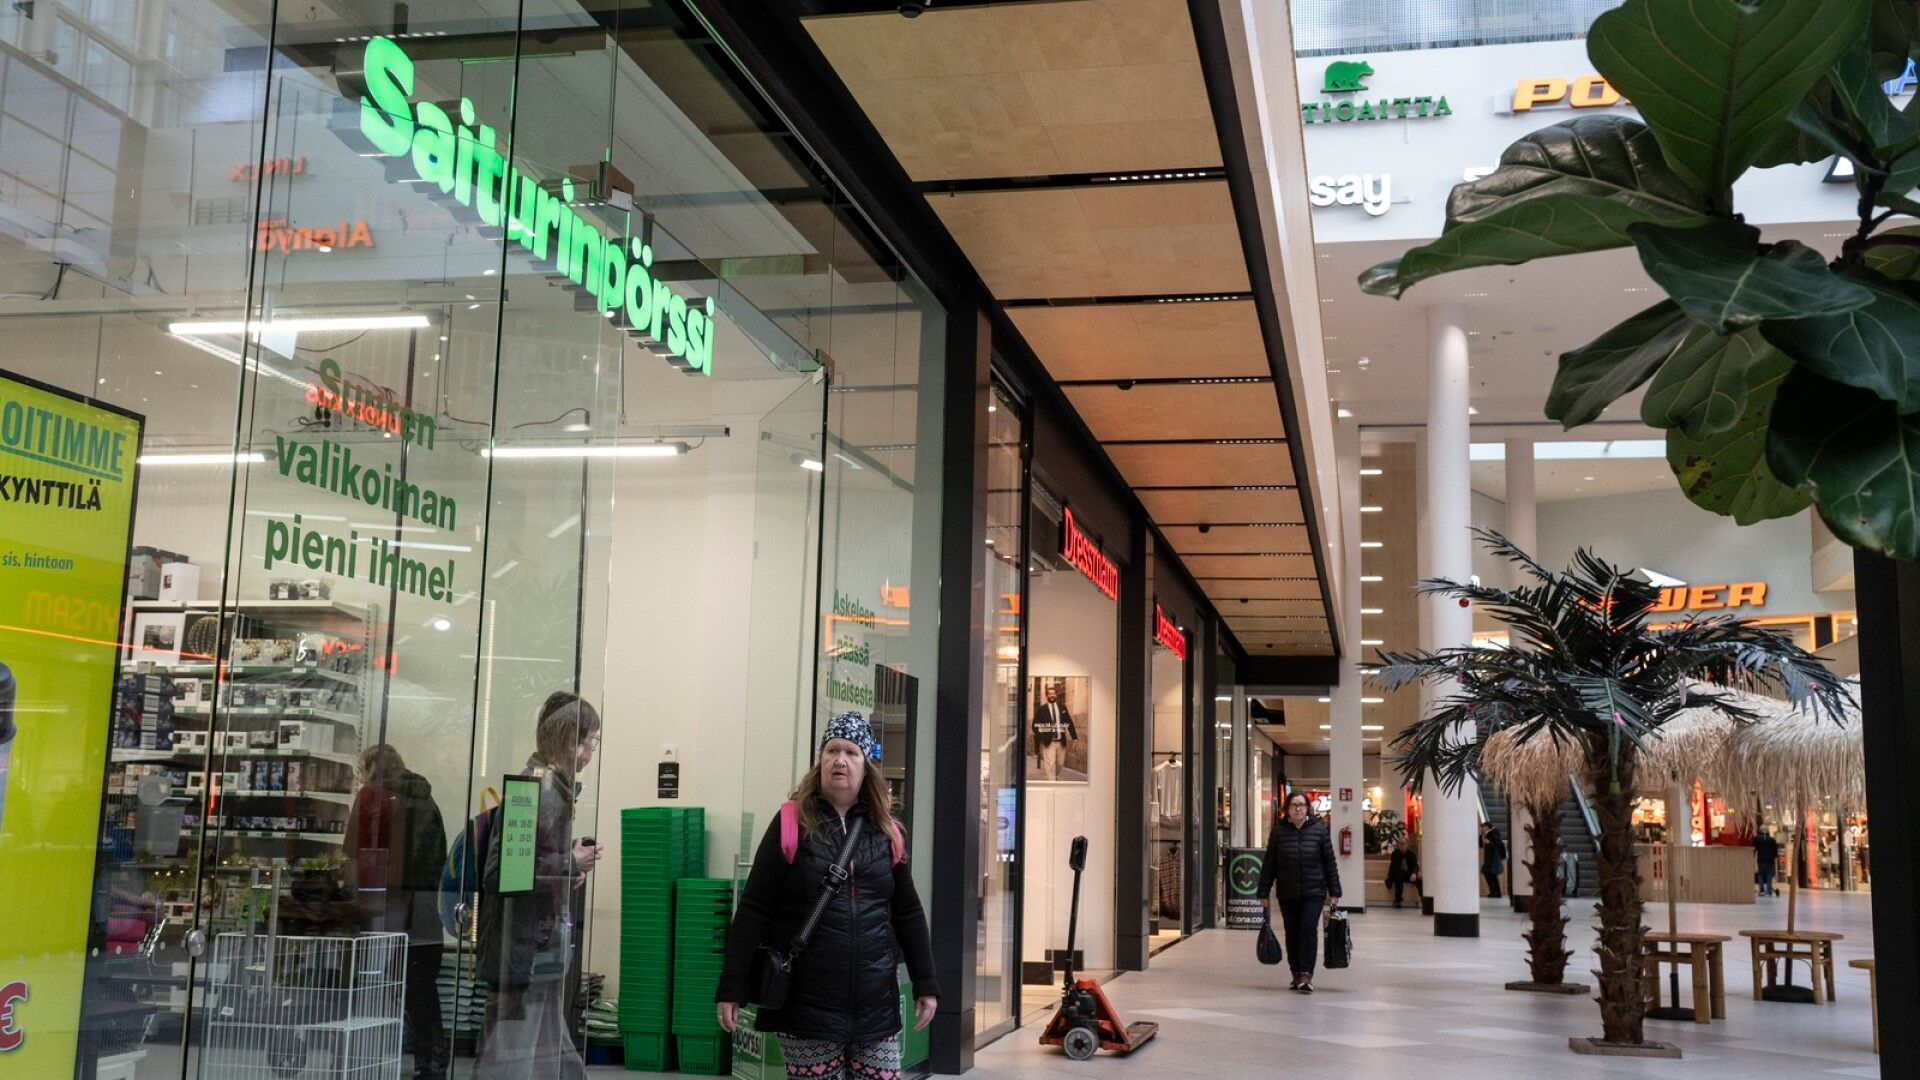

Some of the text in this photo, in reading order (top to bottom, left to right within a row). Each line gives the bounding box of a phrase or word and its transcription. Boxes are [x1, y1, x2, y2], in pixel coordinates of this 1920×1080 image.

[1511, 76, 1632, 113] PO
[360, 36, 715, 376] Saiturinpörssi
[1309, 173, 1392, 216] say
[2, 400, 126, 475] OITIMME
[275, 435, 457, 532] valikoiman
[2, 551, 74, 570] sis. hintaan
[263, 514, 457, 604] pieni ihme!
[1064, 506, 1118, 602] Dressmann
[832, 589, 876, 629] Askeleen
[826, 671, 873, 708] ilmaisesta
